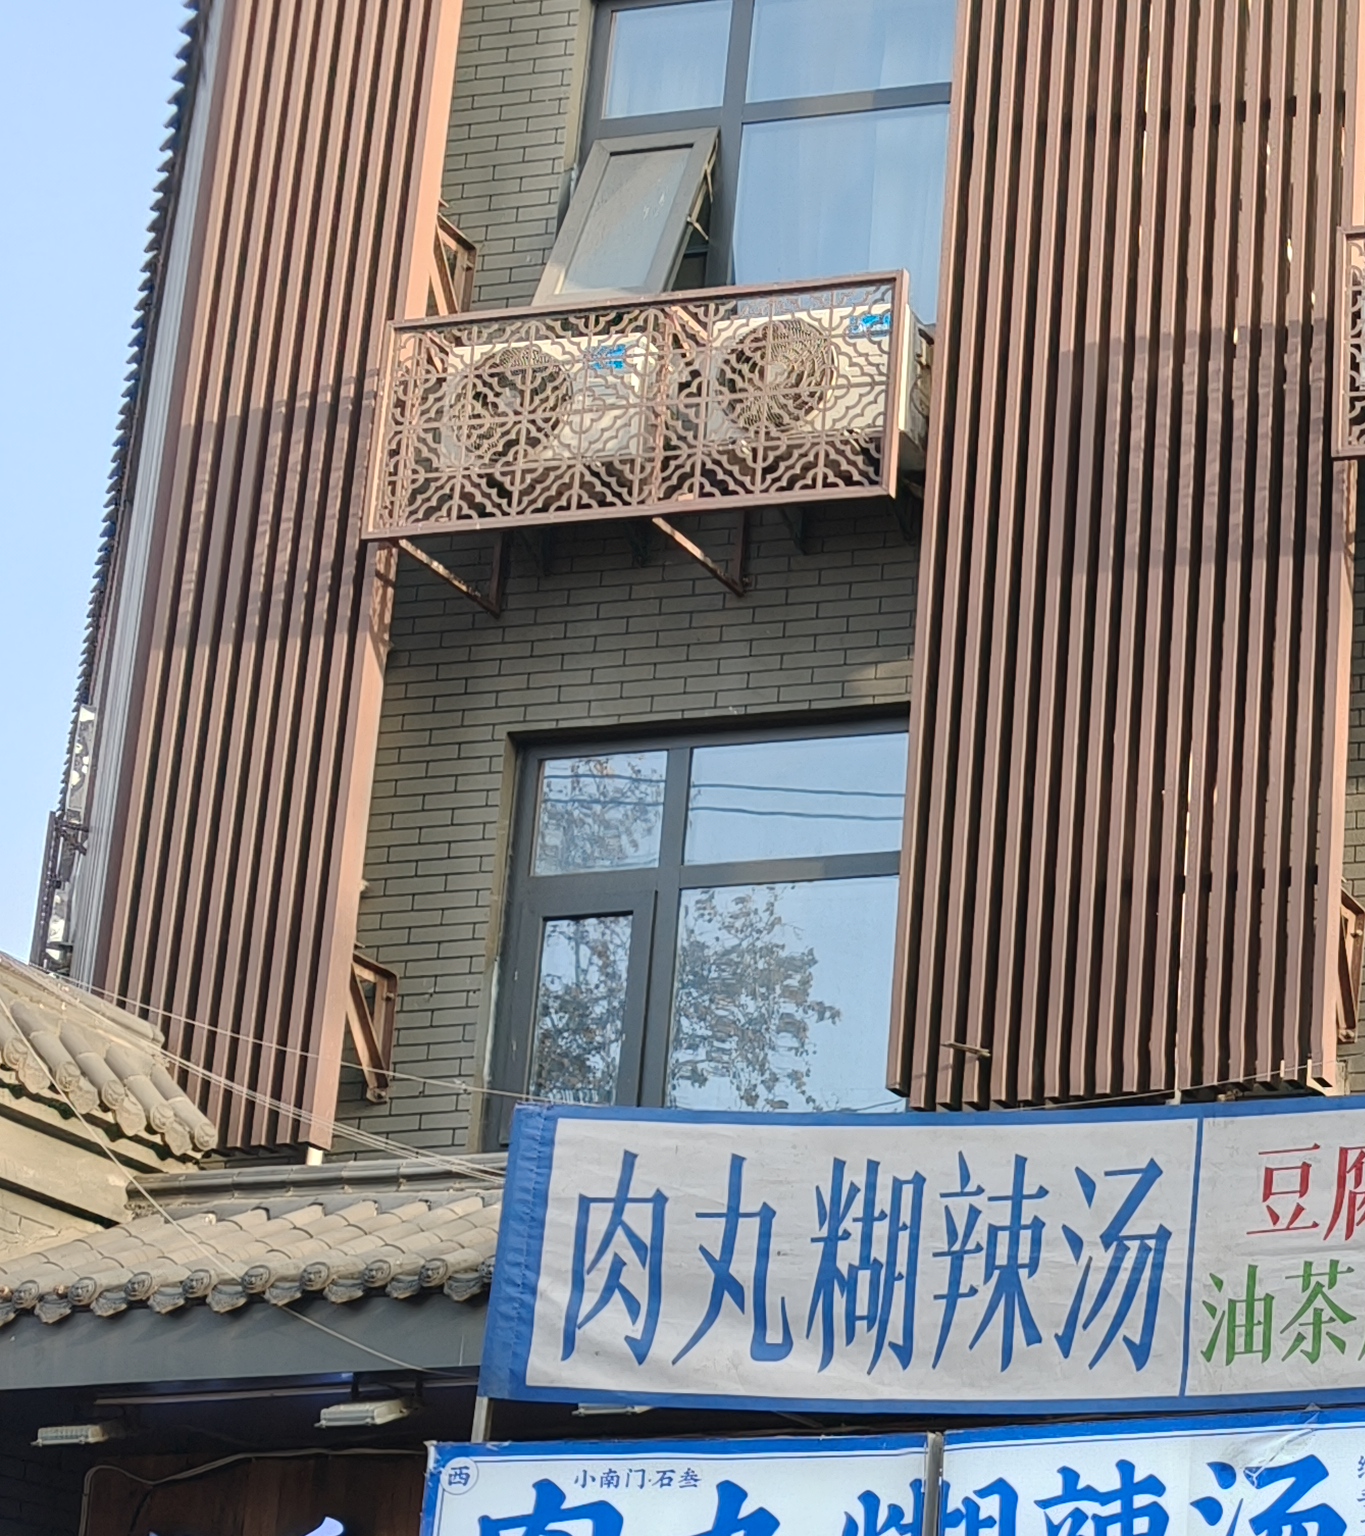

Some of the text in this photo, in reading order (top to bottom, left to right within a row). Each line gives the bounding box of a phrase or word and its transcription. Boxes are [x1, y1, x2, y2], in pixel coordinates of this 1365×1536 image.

[561, 1150, 1172, 1375] 肉丸糊辣汤
[447, 1466, 471, 1486] 西
